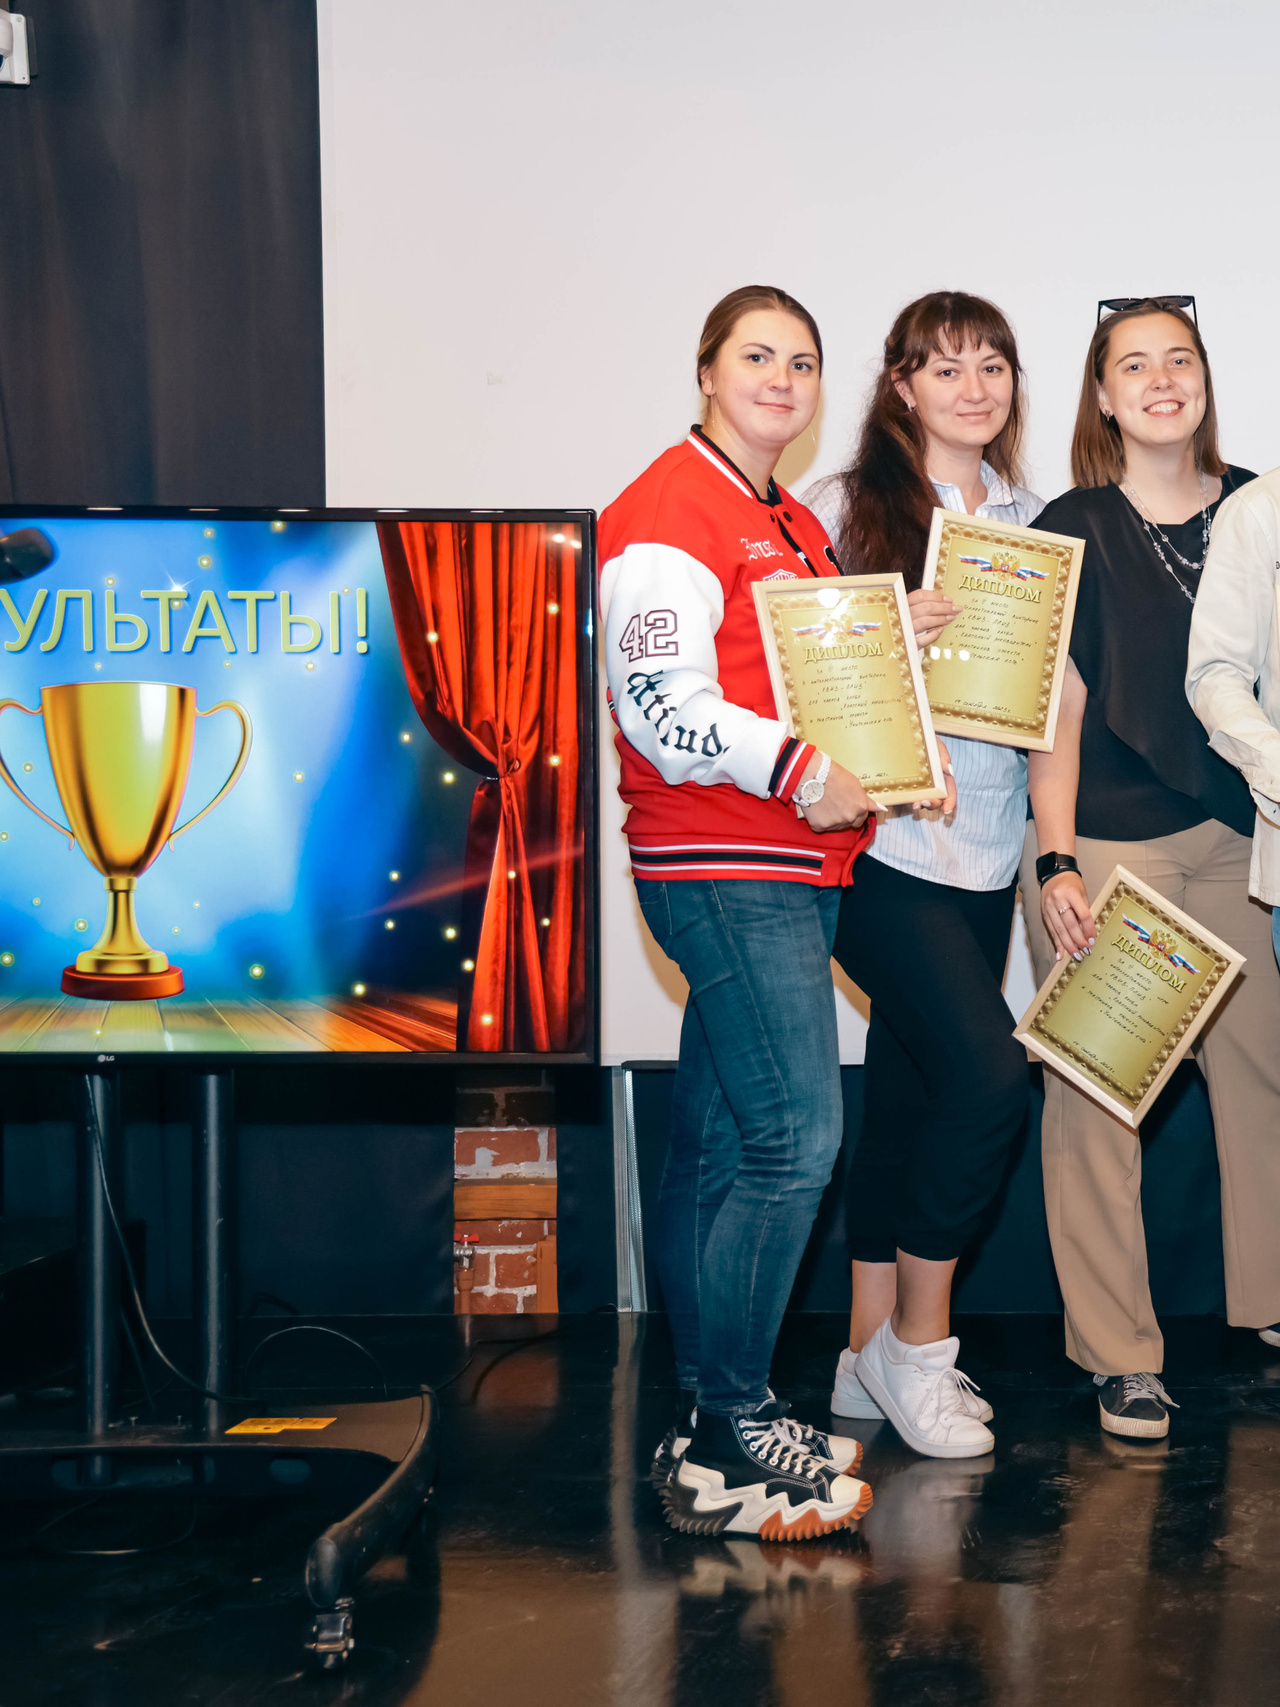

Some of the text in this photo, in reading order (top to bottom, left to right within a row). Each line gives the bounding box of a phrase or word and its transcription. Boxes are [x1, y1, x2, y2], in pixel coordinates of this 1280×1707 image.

[958, 574, 1042, 603] ДИПЛОМ
[0, 588, 369, 654] УЛЬТАТЫ!
[619, 609, 679, 663] 42
[804, 642, 884, 664] ДИПЛОМ
[1111, 934, 1187, 993] ДИПЛОМ
